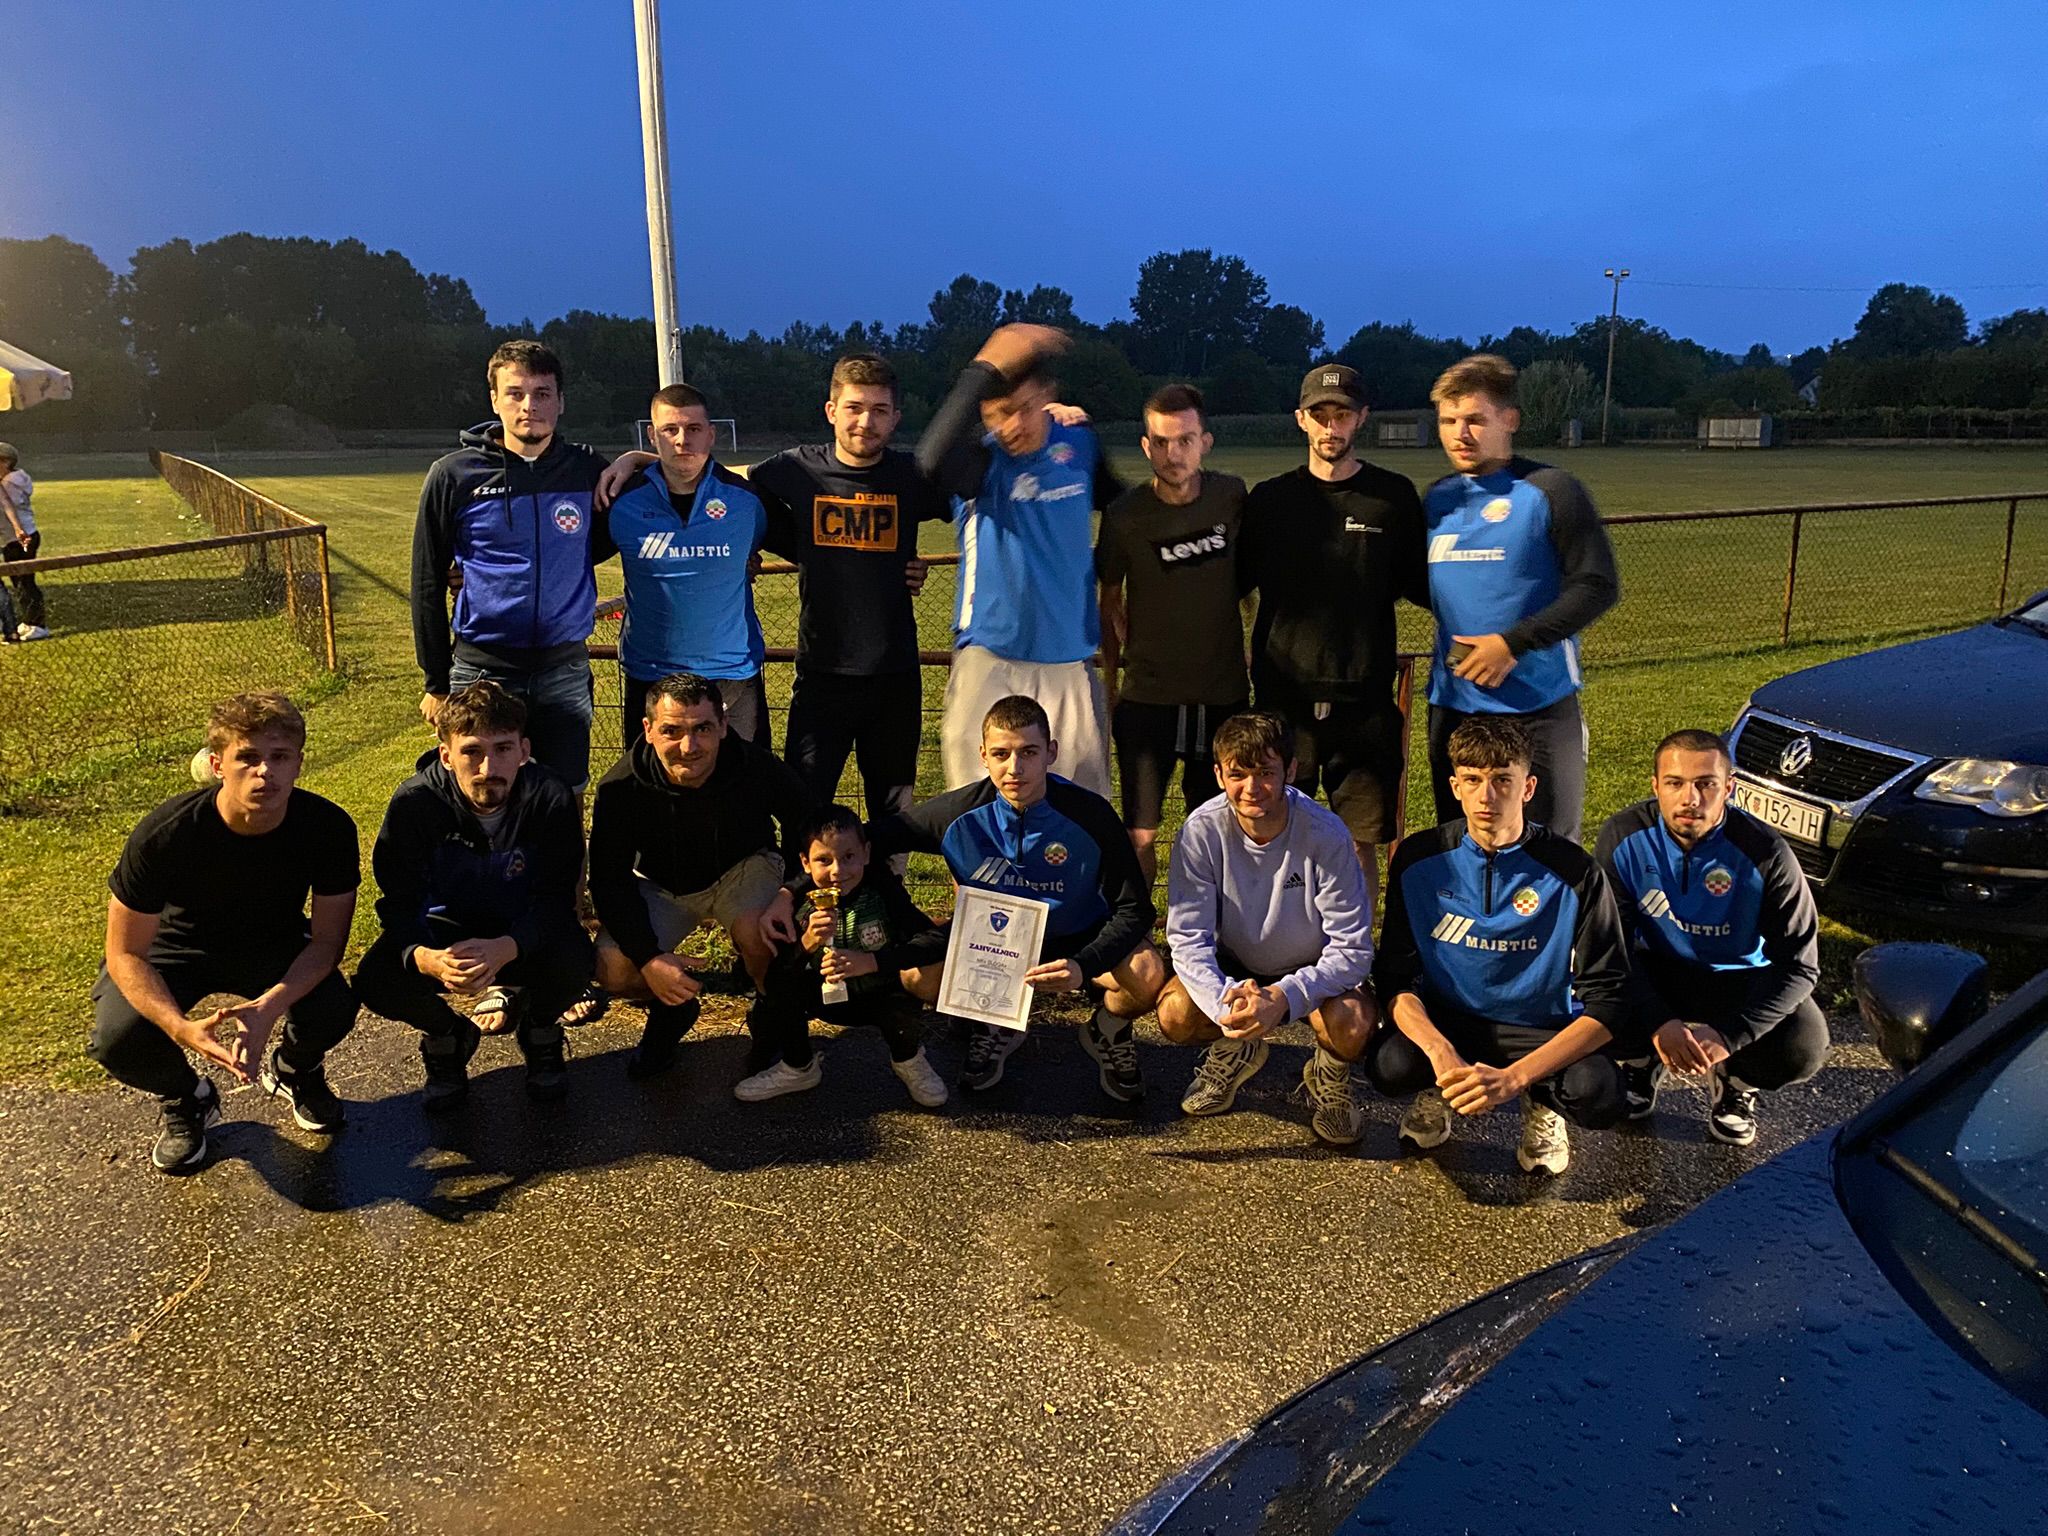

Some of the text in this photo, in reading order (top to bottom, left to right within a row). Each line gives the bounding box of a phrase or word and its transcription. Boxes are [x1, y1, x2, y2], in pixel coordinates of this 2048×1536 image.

[821, 505, 893, 542] CMP
[669, 543, 731, 558] MAJETIĆ
[969, 942, 1020, 959] ZAHVALNICU
[1465, 935, 1538, 951] MAJETIĆ
